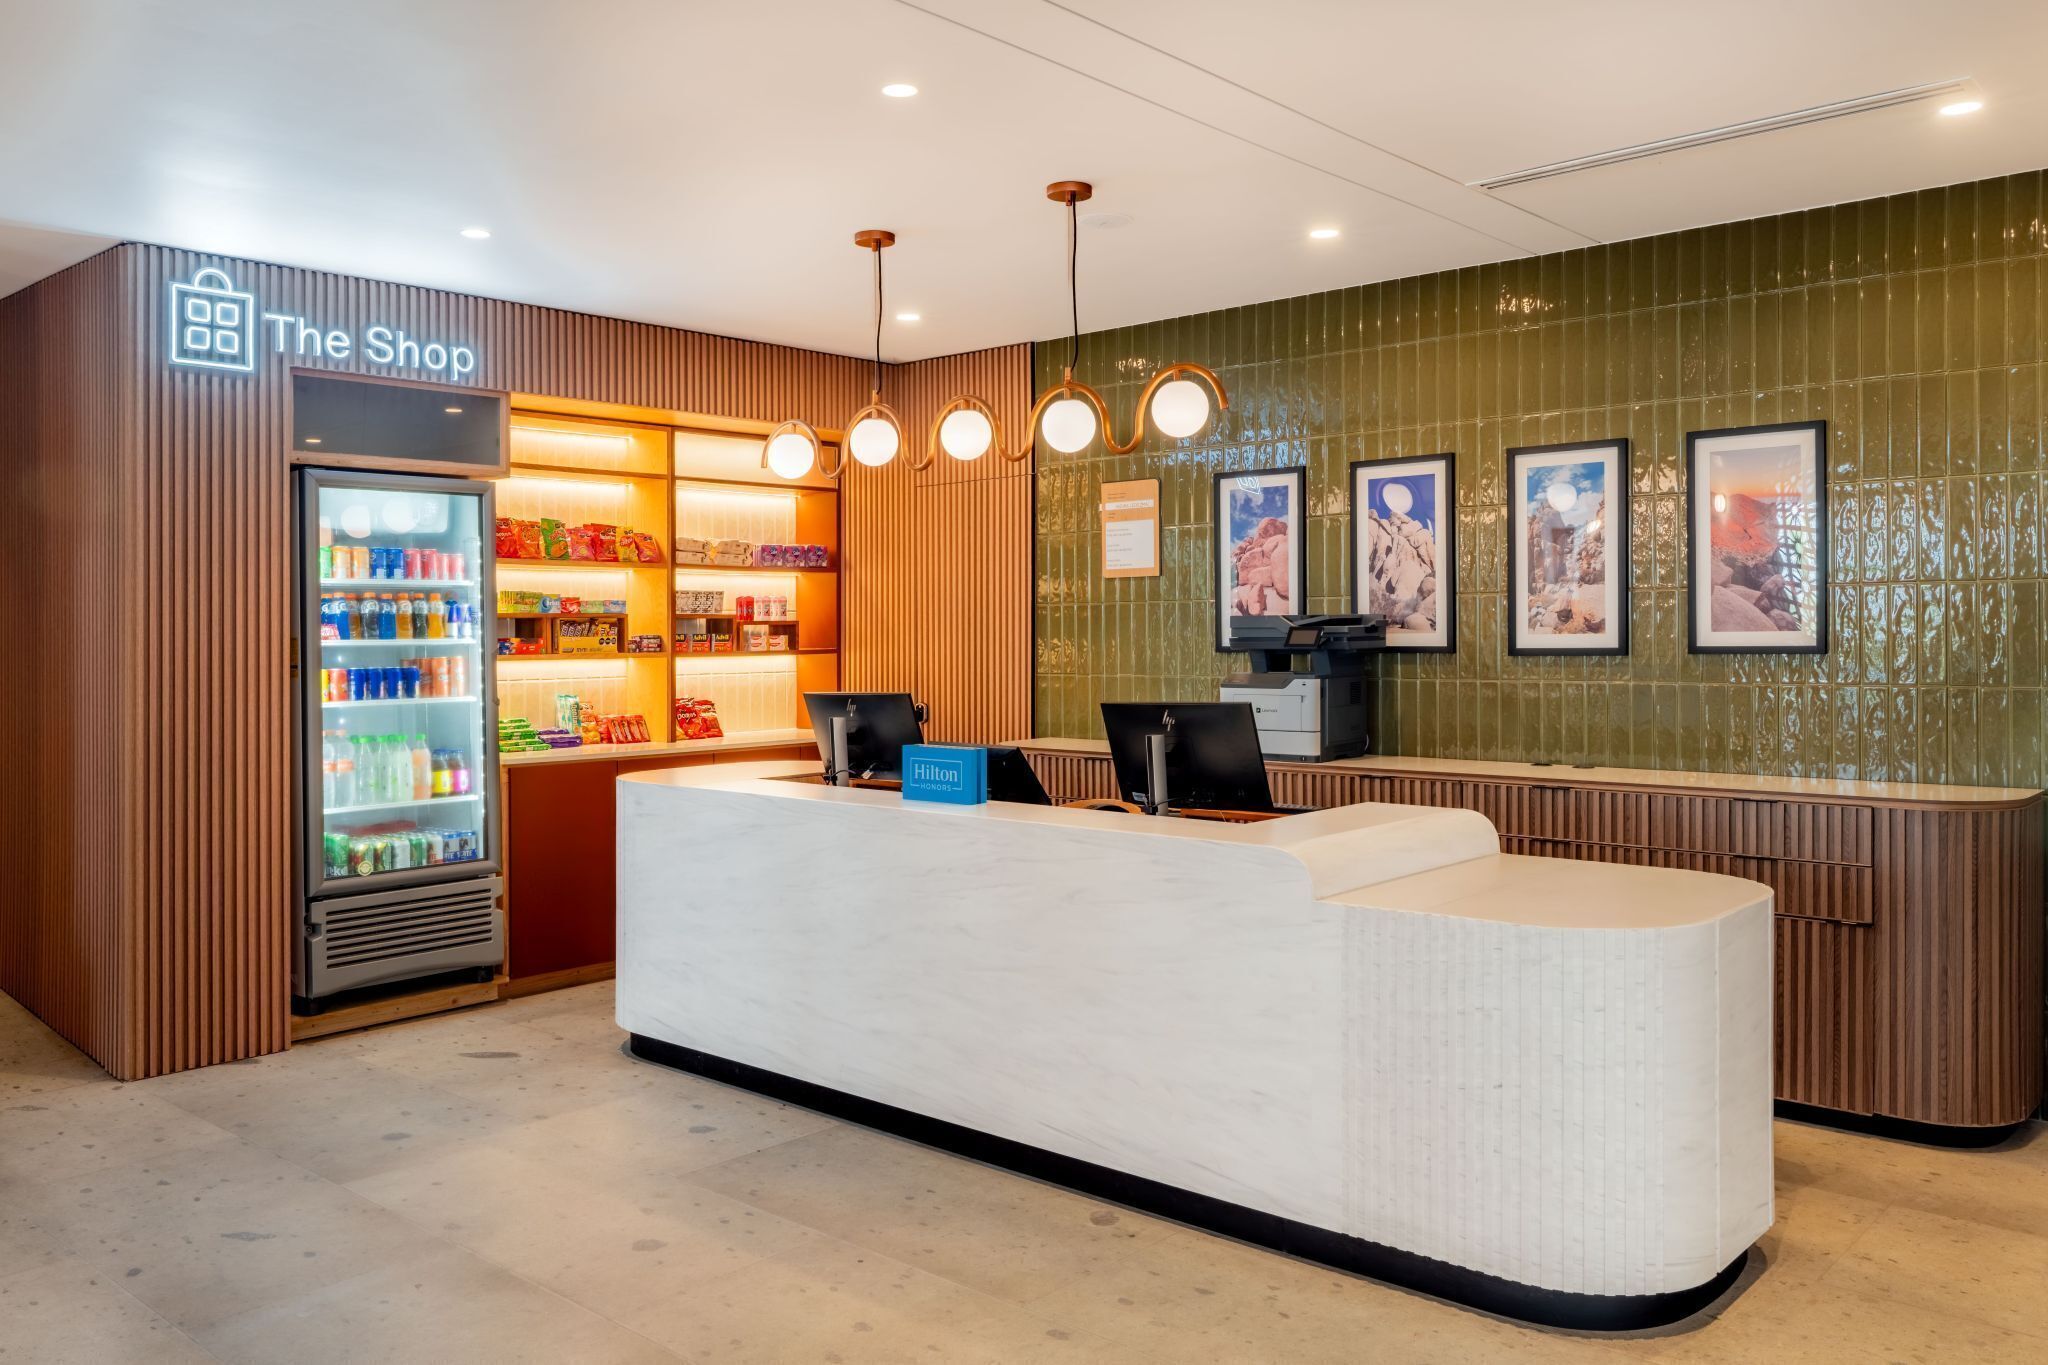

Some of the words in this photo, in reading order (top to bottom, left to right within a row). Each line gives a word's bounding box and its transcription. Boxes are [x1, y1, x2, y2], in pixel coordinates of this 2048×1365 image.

[264, 313, 350, 358] The
[365, 326, 474, 380] Shop
[914, 763, 958, 782] Hilton
[920, 783, 951, 791] HONORS
